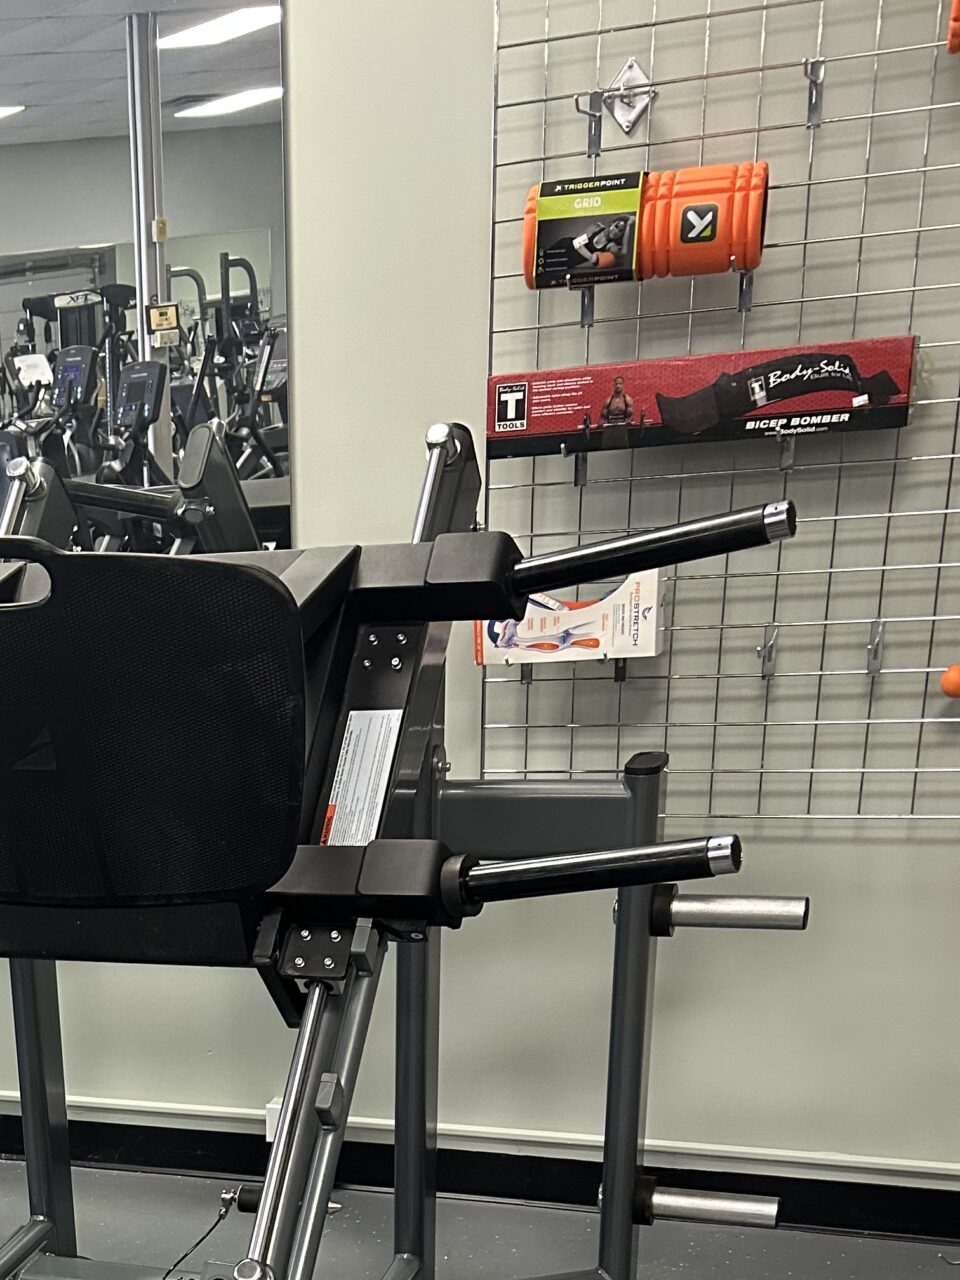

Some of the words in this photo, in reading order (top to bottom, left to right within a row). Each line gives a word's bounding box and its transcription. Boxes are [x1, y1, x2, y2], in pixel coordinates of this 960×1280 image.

[563, 178, 626, 191] TRIGGERPOINT
[574, 196, 602, 209] GRID
[500, 391, 524, 420] T
[497, 421, 525, 430] TOOLS
[745, 418, 787, 430] BICEP
[790, 413, 850, 426] BOMBER
[632, 581, 641, 647] PROSTRETCH
